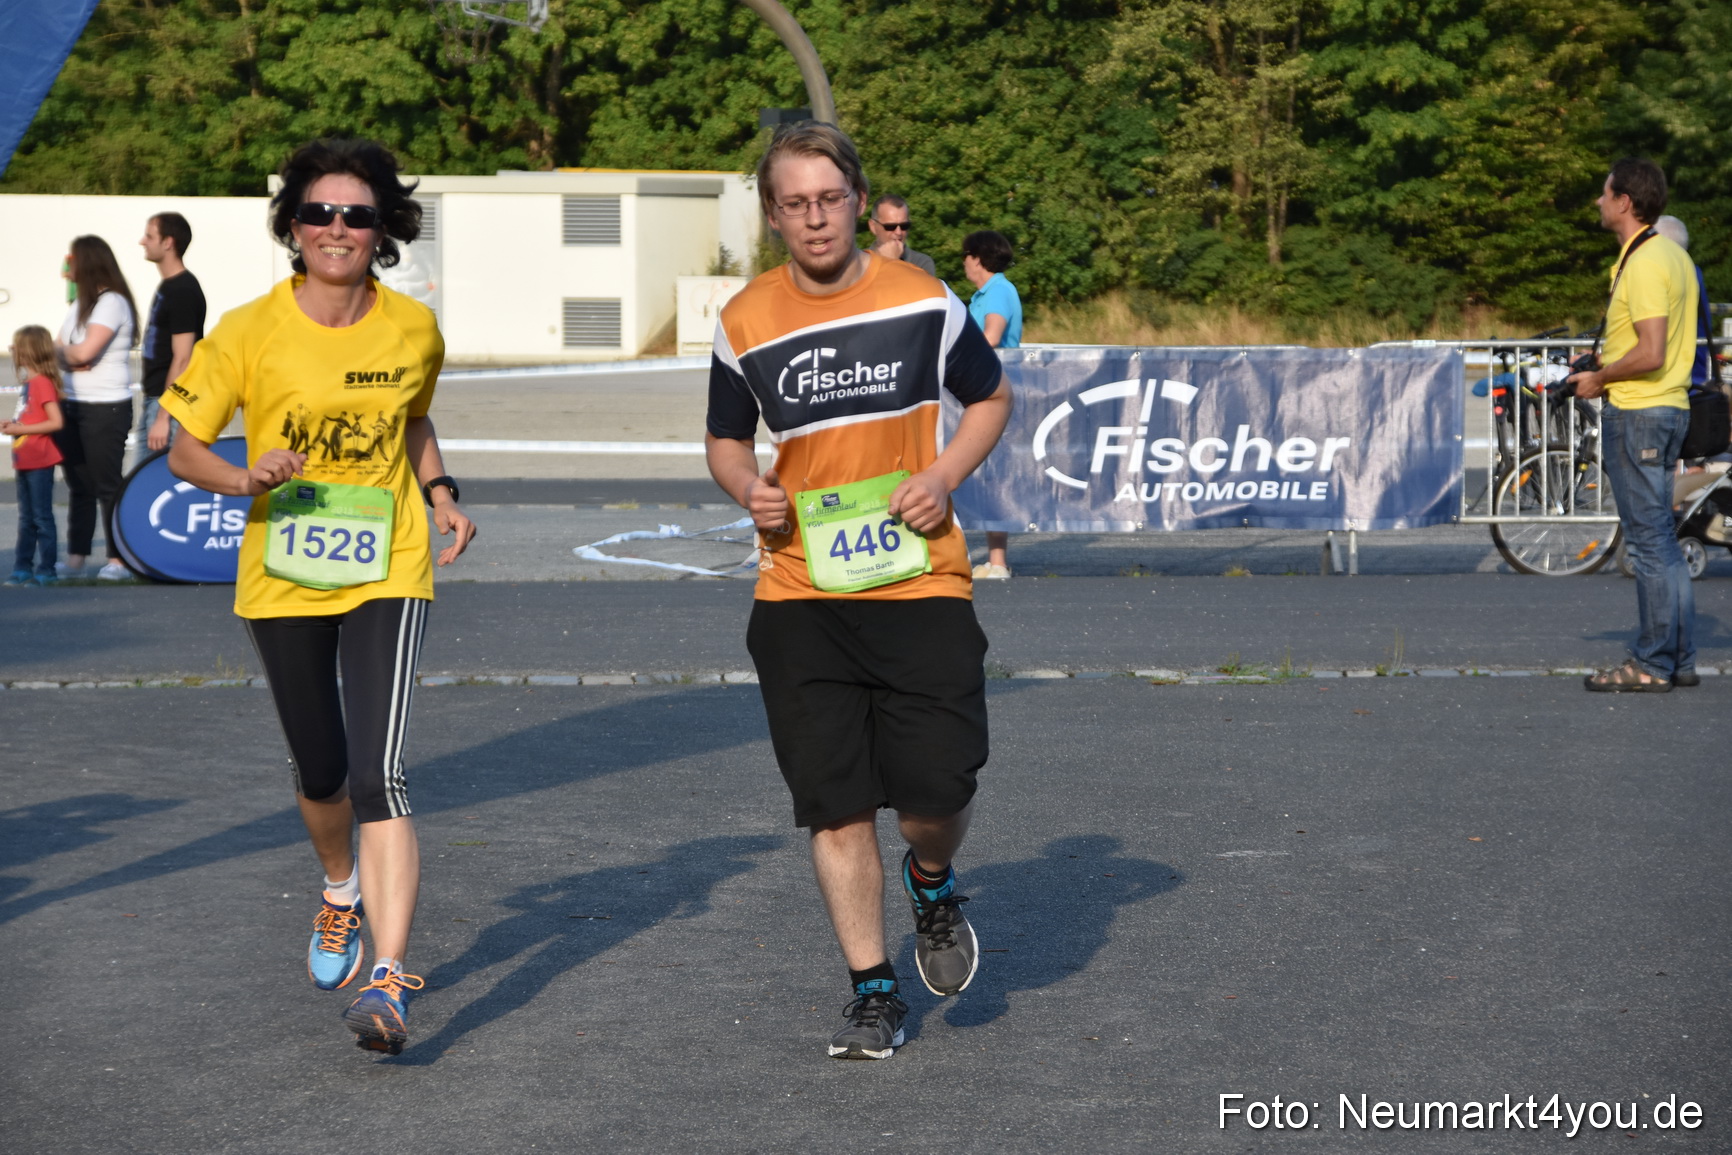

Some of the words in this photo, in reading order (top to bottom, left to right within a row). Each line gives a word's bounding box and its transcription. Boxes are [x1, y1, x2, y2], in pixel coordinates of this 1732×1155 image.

[797, 360, 903, 395] Fischer
[808, 381, 897, 405] AUTOMOBILE
[1090, 424, 1351, 474] Fischer
[1113, 480, 1329, 503] AUTOMOBILE
[280, 522, 376, 564] 1528
[829, 518, 901, 562] 446
[846, 564, 875, 576] Thomas
[875, 560, 895, 570] Barth
